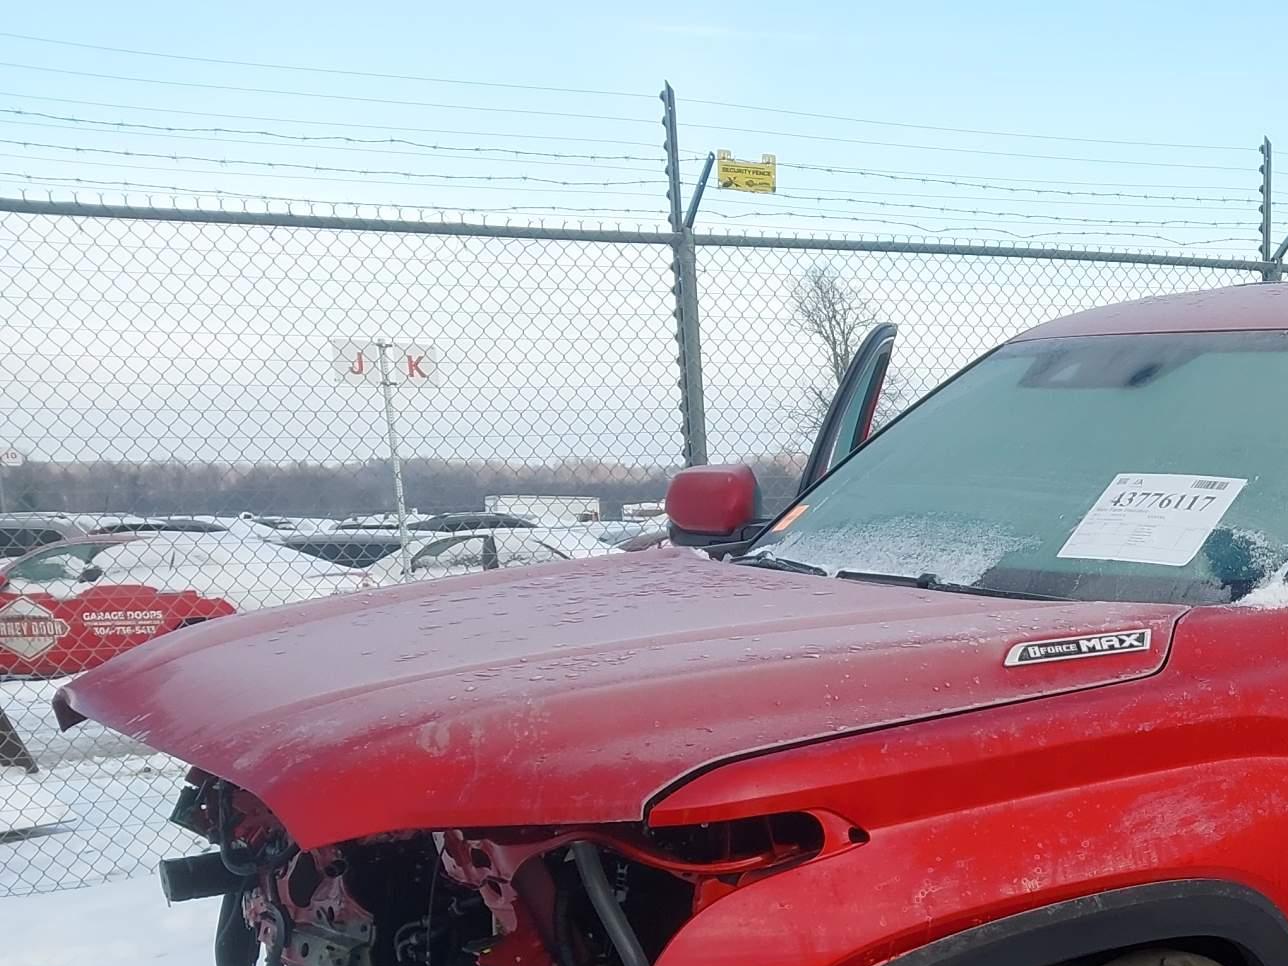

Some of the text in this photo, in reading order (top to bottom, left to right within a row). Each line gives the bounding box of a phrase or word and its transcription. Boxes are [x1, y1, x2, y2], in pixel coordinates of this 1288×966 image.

[349, 351, 364, 375] J
[406, 354, 428, 378] K
[1111, 490, 1217, 513] 43776117
[82, 610, 163, 621] GARAGE DOORS
[1079, 633, 1143, 652] MAX
